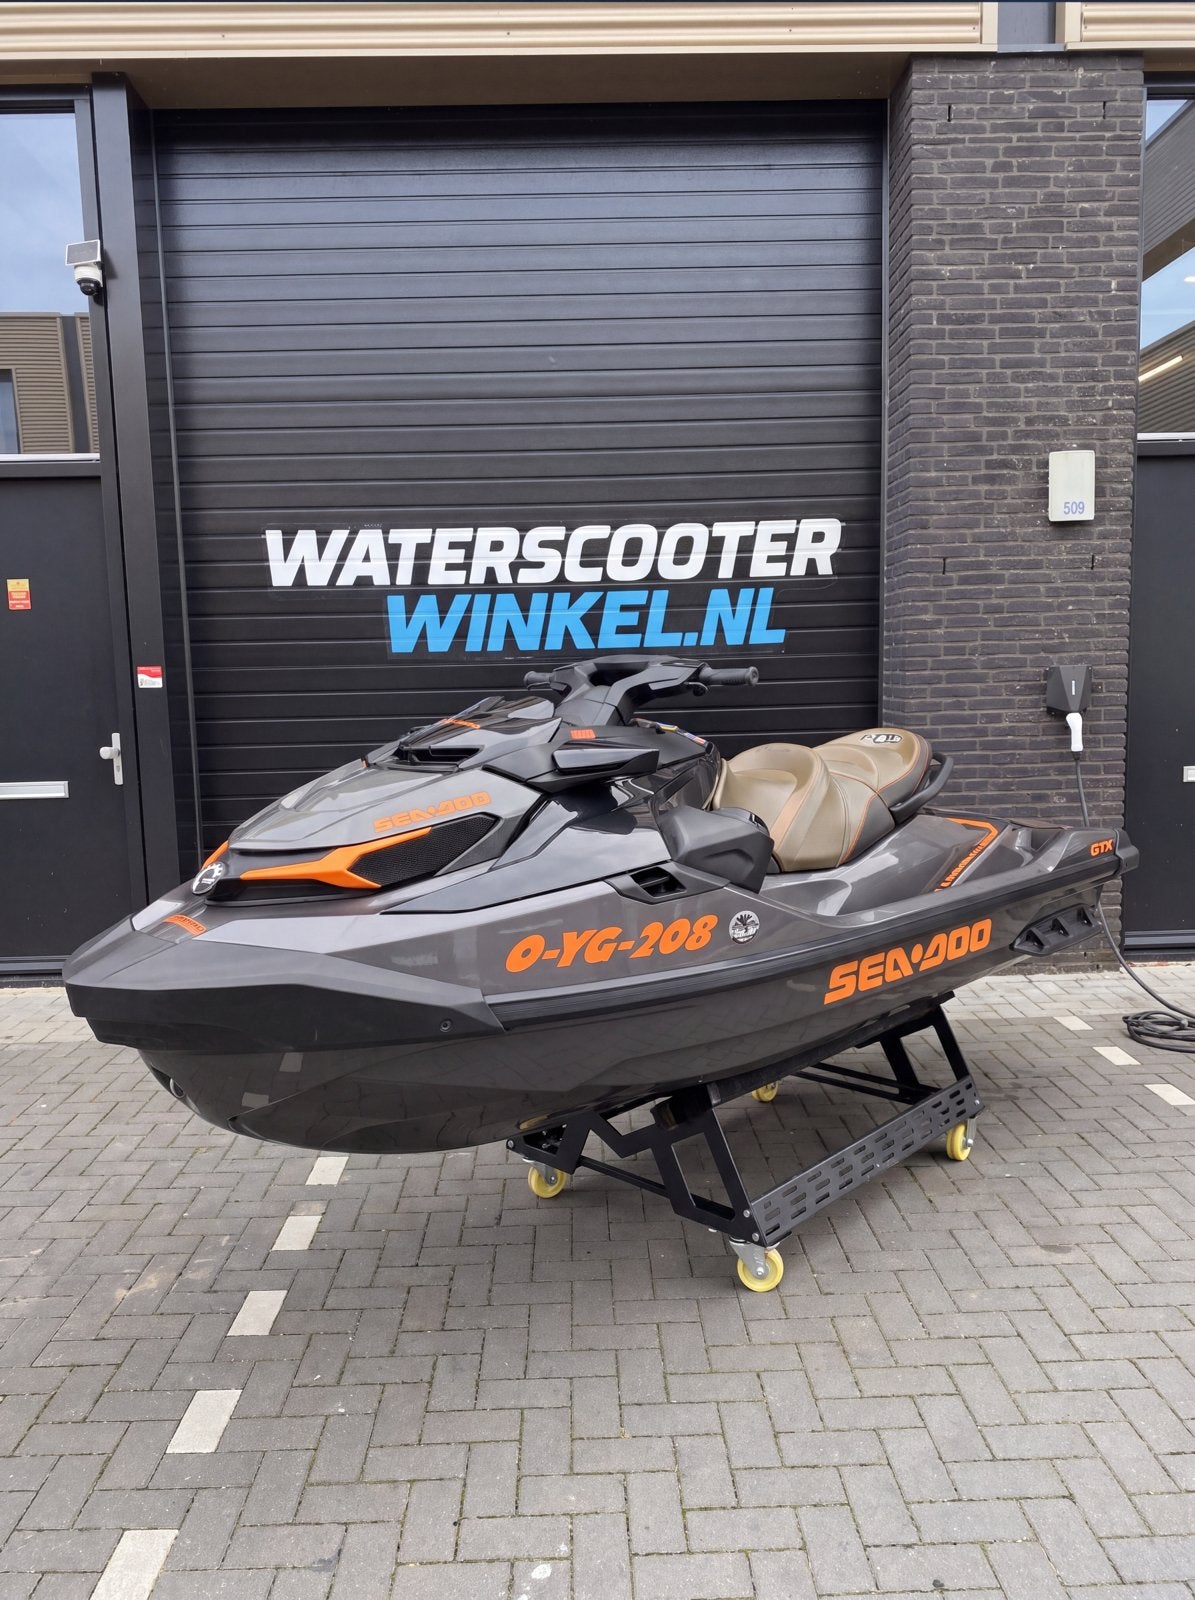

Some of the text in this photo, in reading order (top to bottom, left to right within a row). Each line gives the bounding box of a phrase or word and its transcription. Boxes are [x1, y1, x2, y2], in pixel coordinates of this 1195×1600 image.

[1063, 501, 1085, 515] 509
[264, 518, 843, 587] WATERSCOOTER
[386, 587, 787, 654] WINKEL.NL
[1090, 839, 1114, 857] GTX
[505, 914, 719, 973] O-YG-208
